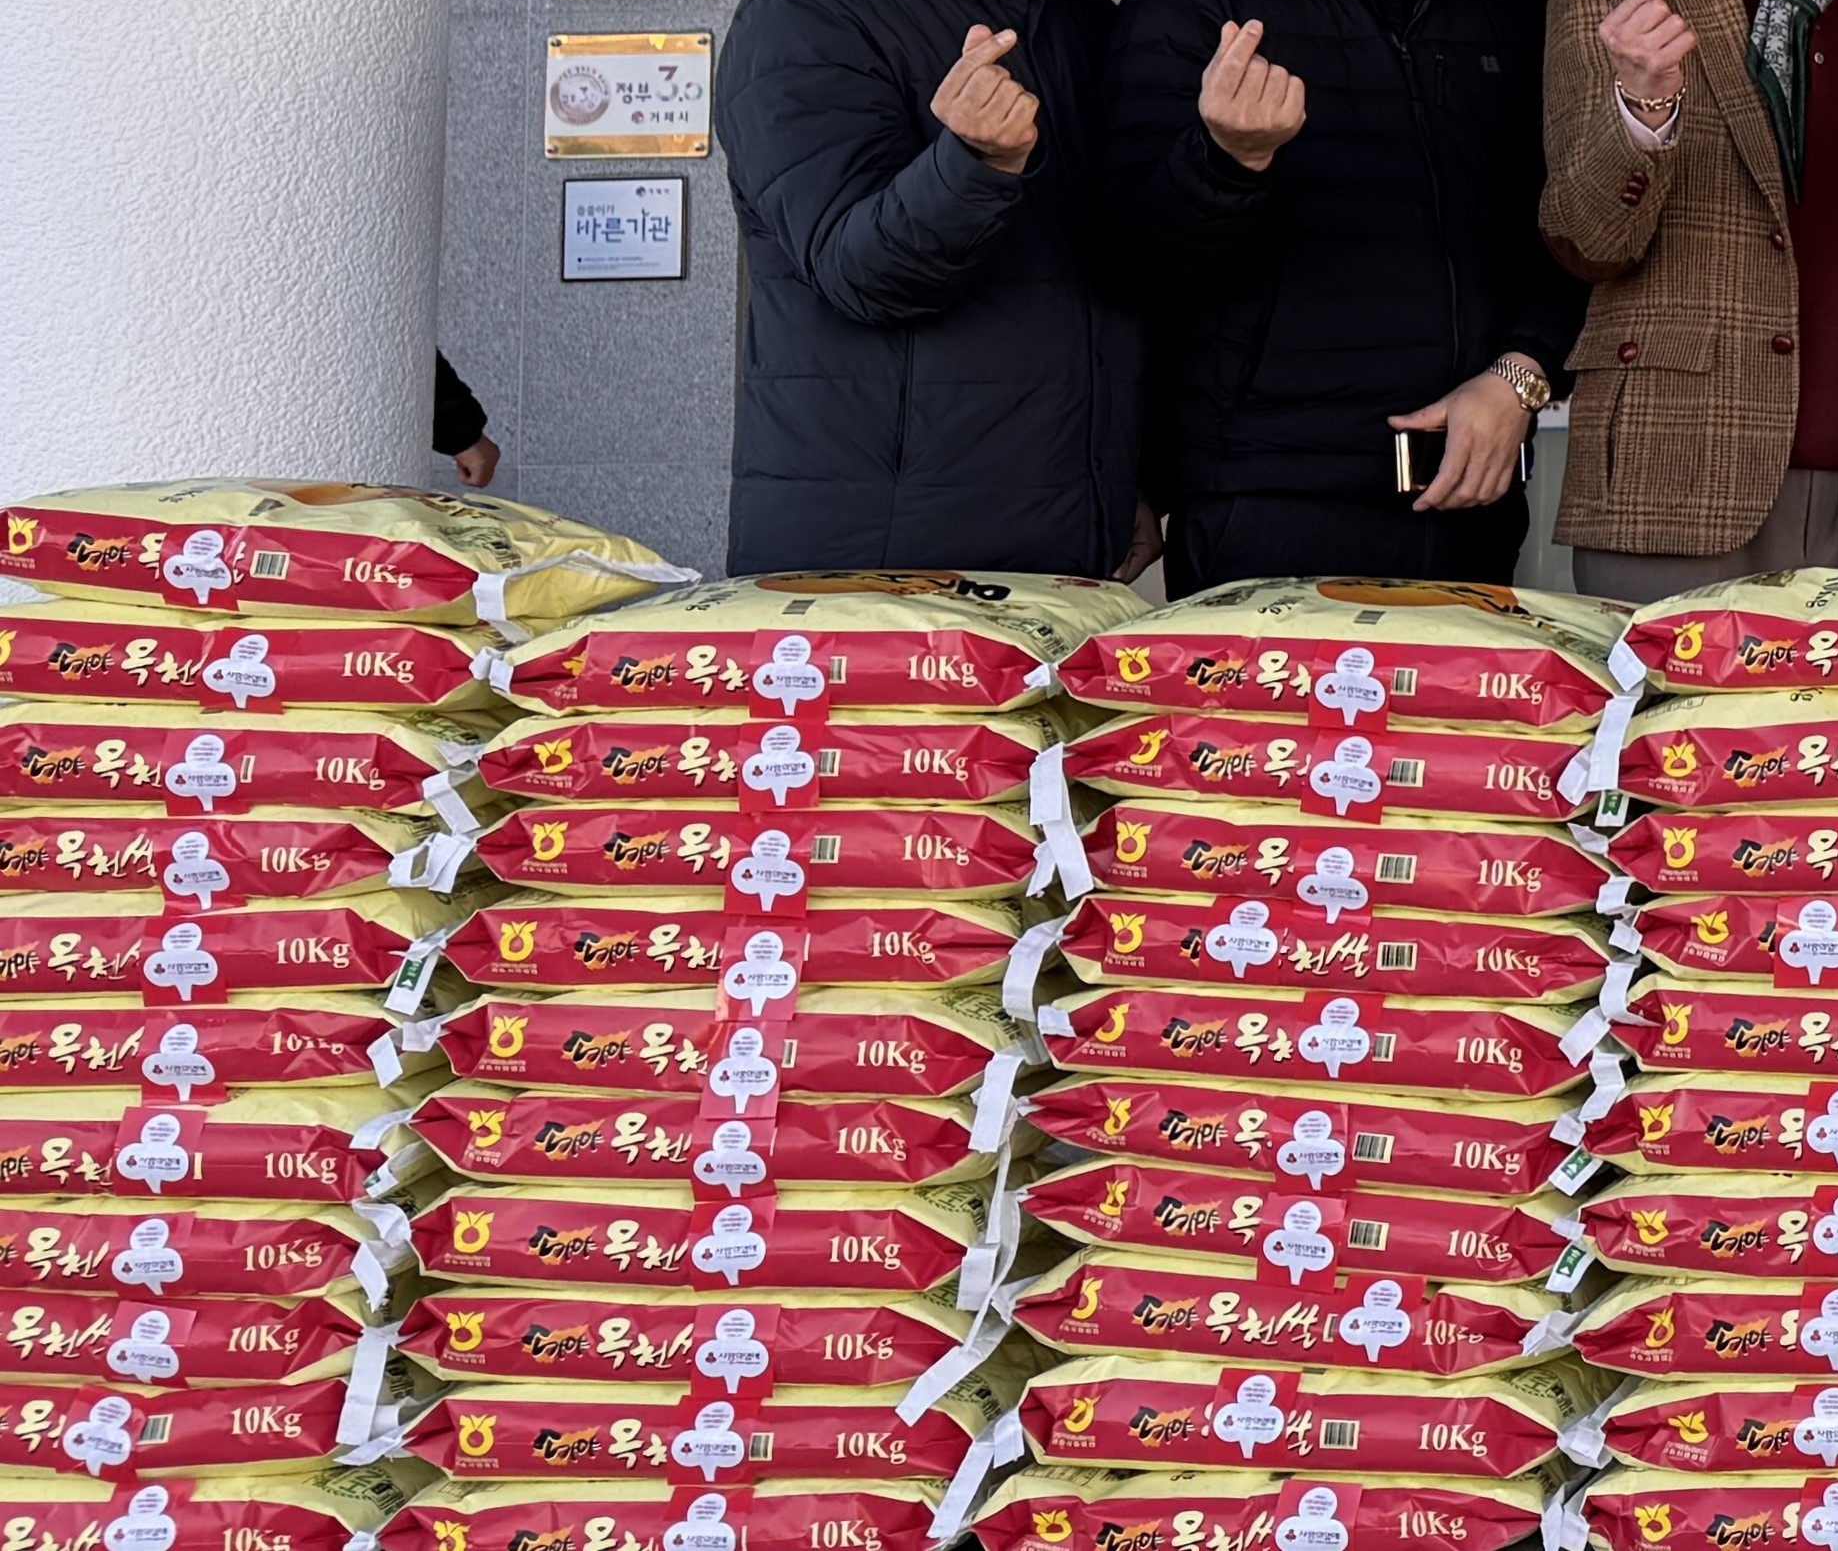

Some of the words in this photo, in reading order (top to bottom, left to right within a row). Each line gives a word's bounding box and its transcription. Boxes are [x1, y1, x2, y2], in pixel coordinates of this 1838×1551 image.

[615, 81, 652, 105] 정부
[655, 65, 704, 103] 3.0
[576, 207, 672, 244] 바른기관
[343, 651, 413, 683] 10Kg
[909, 656, 979, 687] 10Kg
[1479, 673, 1542, 704] 10Kg
[316, 757, 385, 790] 10Kg
[903, 749, 967, 781] 10Kg
[1486, 764, 1552, 800] 10Kg
[904, 835, 969, 865] 10Kg
[1479, 860, 1541, 892] 10Kg
[277, 938, 350, 968] 10Kg
[871, 932, 935, 963] 10Kg
[857, 1040, 925, 1074] 10Kg
[1457, 1037, 1523, 1073] 10Kg
[838, 1127, 905, 1161] 10Kg
[1454, 1141, 1520, 1175] 10Kg
[266, 1153, 337, 1184] 10Kg
[246, 1240, 322, 1270] 10Kg
[831, 1236, 901, 1270] 10Kg
[228, 1325, 297, 1354] 10Kg
[825, 1334, 893, 1360] 10Kg
[232, 1405, 302, 1438] 10Kg
[837, 1432, 907, 1464] 10Kg
[1420, 1425, 1487, 1457] 10Kg
